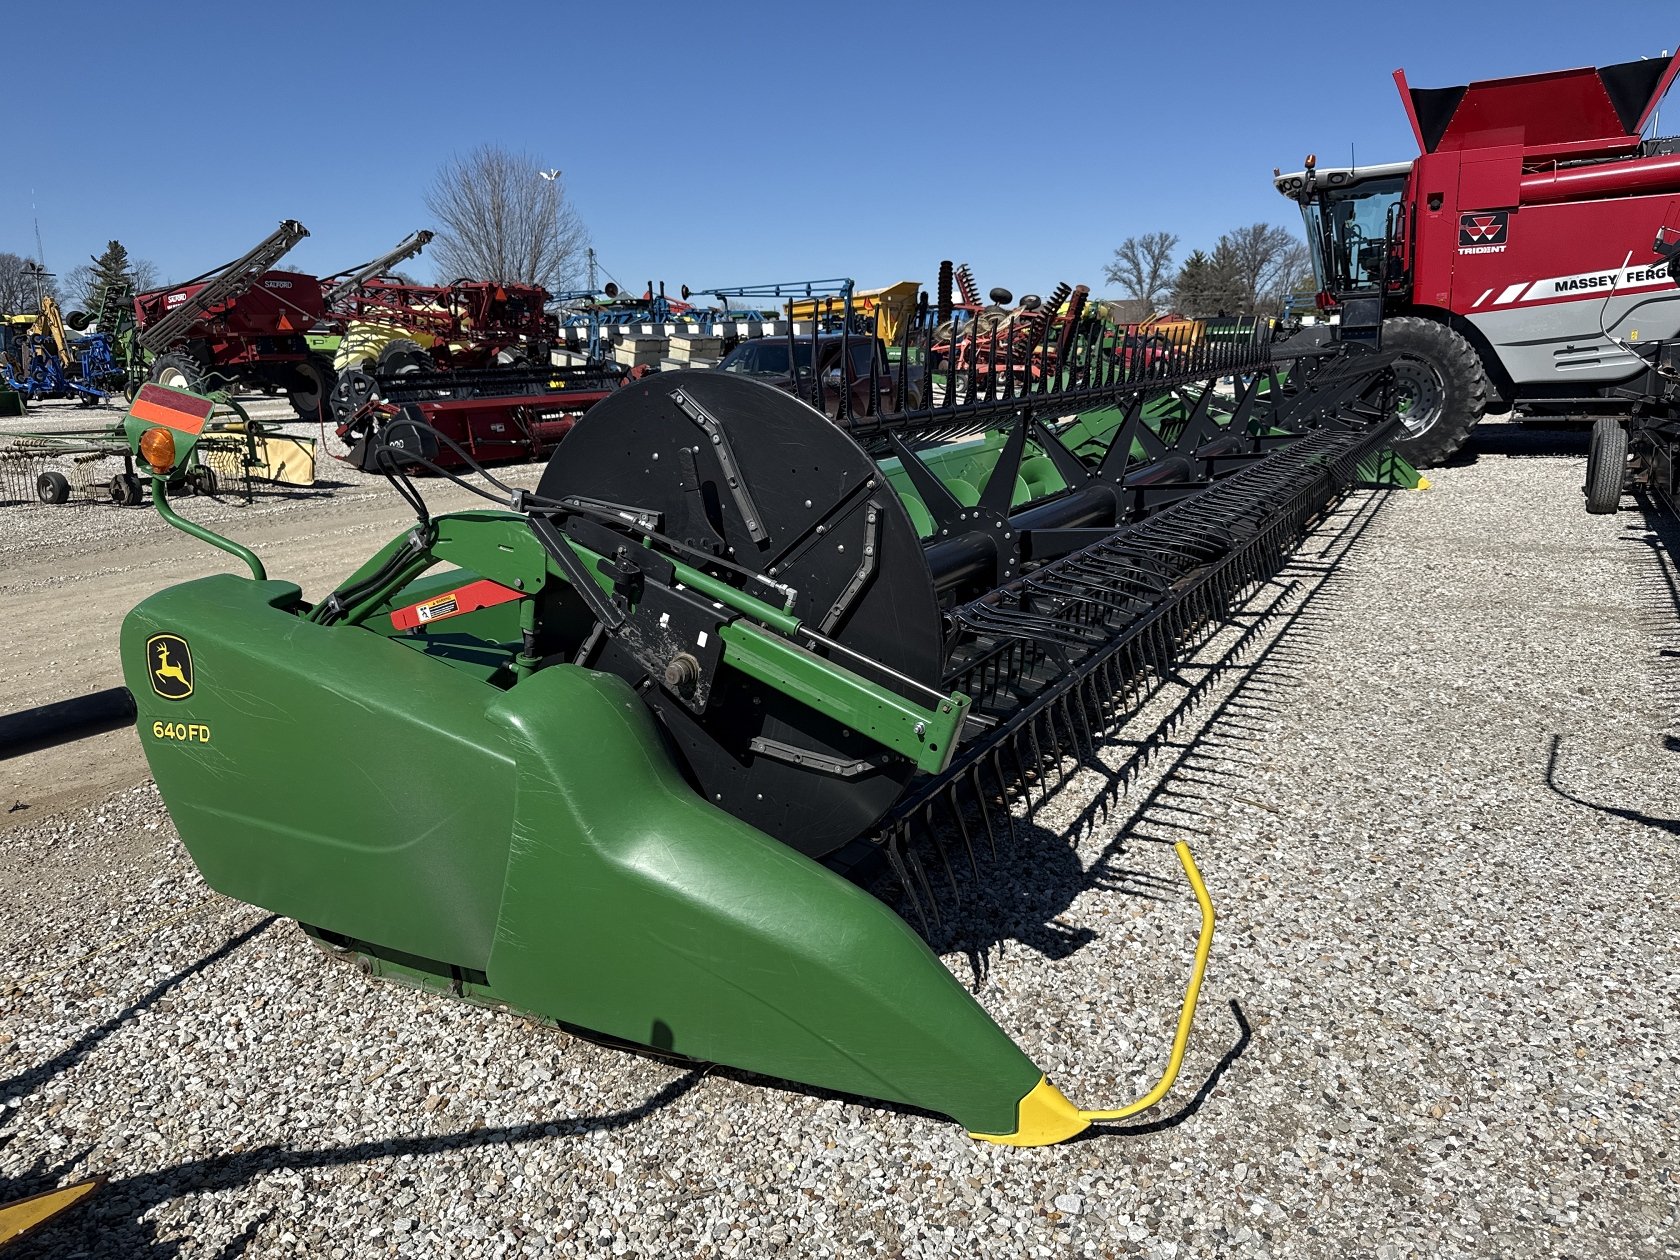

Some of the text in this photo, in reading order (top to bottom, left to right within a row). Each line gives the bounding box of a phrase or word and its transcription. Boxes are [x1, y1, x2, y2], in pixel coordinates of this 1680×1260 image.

[1457, 245, 1507, 255] TRIDENT
[264, 280, 293, 289] SALFORD
[1554, 268, 1667, 292] MASSEY FERG
[153, 721, 211, 743] 640FD
